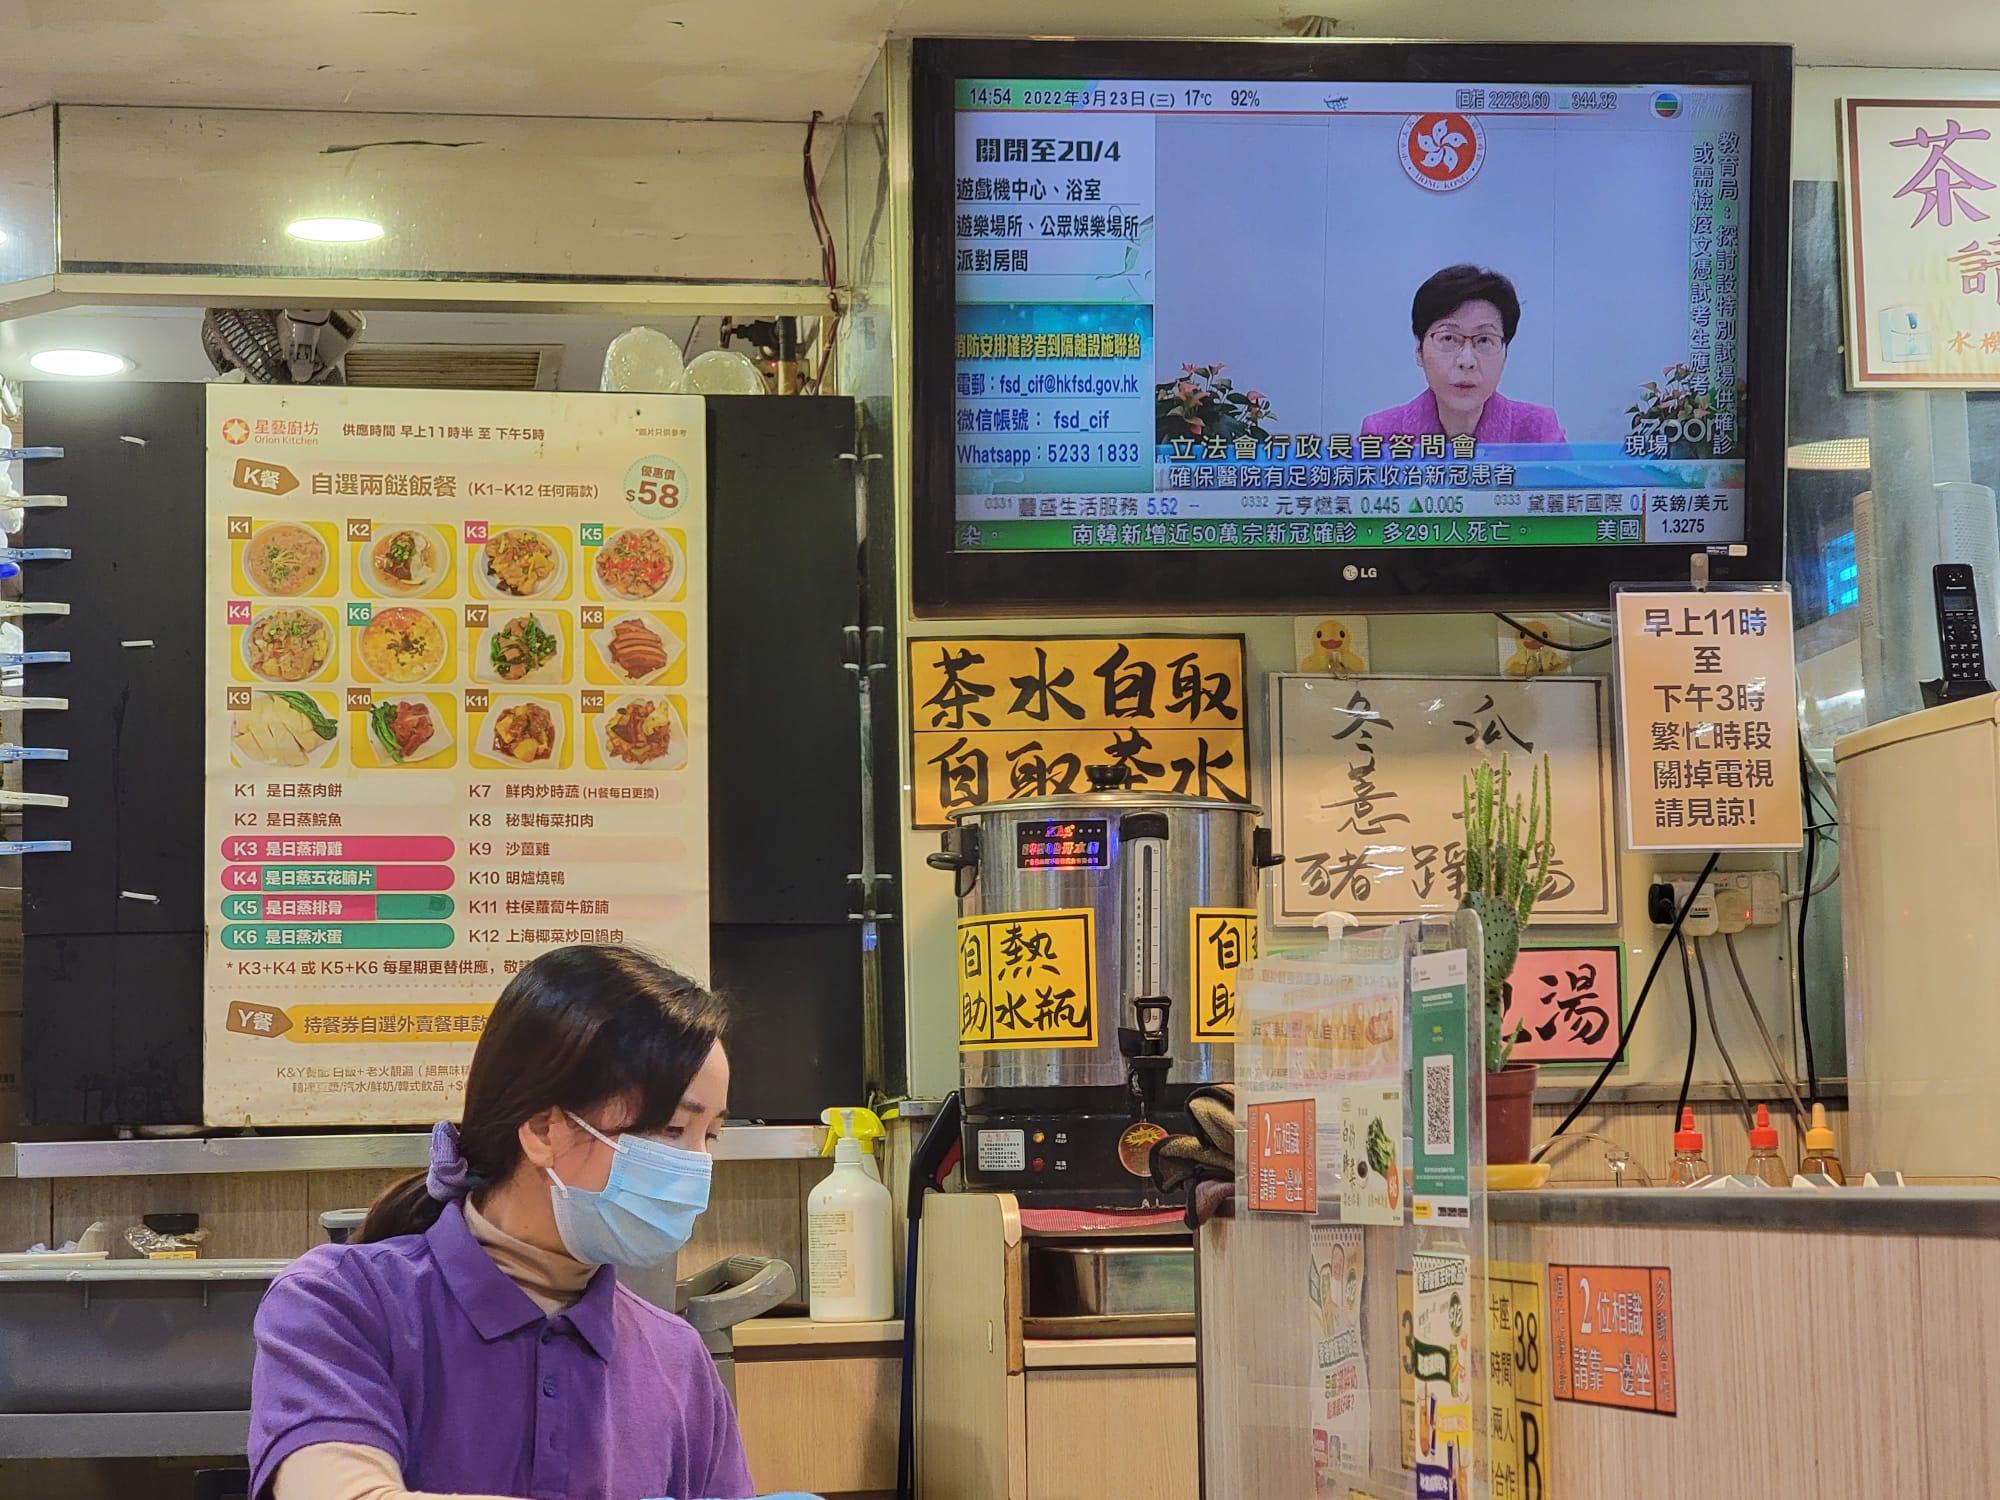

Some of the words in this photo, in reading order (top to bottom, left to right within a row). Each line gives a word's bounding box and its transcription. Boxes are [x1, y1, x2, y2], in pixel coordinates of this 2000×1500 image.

[970, 88, 1012, 105] 14:54
[1231, 90, 1260, 107] 92%
[976, 138, 1121, 163] 關閉至20/4
[1889, 118, 1998, 229] 茶
[956, 178, 1101, 201] 遊戲機中心、浴室
[956, 215, 1139, 238] 遊樂場所、公眾娛樂場所
[956, 249, 1028, 272] 派對房間
[254, 419, 319, 436] 星藝廚坊
[343, 423, 396, 437] 供應時間
[400, 424, 473, 439] 早上11時半
[478, 427, 491, 439] 至
[496, 427, 545, 440] 下午5時
[1053, 411, 1110, 433] fsd_cif
[254, 435, 280, 444] Orion
[282, 436, 318, 445] Kitchen
[1169, 433, 1477, 461] 立法會行政長官答問會
[1625, 435, 1668, 456] 現場
[1097, 444, 1139, 463] 1833
[244, 466, 281, 490] K餐
[641, 465, 676, 481] 優惠價
[1169, 464, 1515, 488] 確保醫院有足夠病床收治新冠患者
[311, 472, 457, 498] 自選兩餸飯餐
[1147, 497, 1178, 516] 5.52
[1361, 496, 1400, 514] 0.445
[1652, 494, 1729, 513] 英鎊/美元
[230, 521, 250, 534] K1
[349, 523, 369, 537] K2
[467, 526, 487, 539] K3
[1597, 519, 1640, 541] 美國
[1662, 518, 1705, 535] 1.3275
[582, 528, 602, 542] K5
[1360, 567, 1377, 578] LG
[229, 606, 250, 619] K4
[349, 608, 370, 621] K6
[466, 609, 488, 622] K7
[582, 610, 602, 624] K8
[1643, 607, 1768, 637] 早上11時
[1693, 646, 1722, 674] 至
[921, 642, 1238, 729] 茶水自取
[229, 692, 250, 704] K9
[348, 693, 371, 706] K10
[465, 694, 488, 707] K11
[582, 696, 603, 707] K12
[1653, 683, 1765, 713] 下午3時
[1651, 721, 1772, 751] 繁忙時段
[928, 726, 1248, 808] 自取茶水
[1653, 759, 1774, 789] 關掉電視
[235, 784, 255, 797] K1
[266, 783, 342, 798] 是日蒸肉餅
[469, 785, 491, 797] K7
[505, 784, 580, 798] 鮮肉炒時蔬
[235, 813, 257, 826] K2
[266, 812, 342, 827] 是日蒸鯇魚
[469, 814, 492, 827] K8
[505, 813, 594, 828] 秘製梅菜扣肉
[234, 842, 258, 856] K3
[266, 841, 343, 856] 是日蒸滑雞
[469, 843, 492, 855] K9
[234, 871, 258, 885] K4
[266, 870, 372, 886] 是日蒸五花腩片
[469, 871, 500, 884] K10
[505, 871, 565, 885] 明爐燒鴨
[234, 901, 258, 915] K5
[266, 900, 342, 915] 是日蒸排骨
[469, 900, 497, 913] K11
[233, 930, 257, 944] K6
[265, 929, 342, 945] 是日蒸水蛋
[469, 930, 499, 943] K12
[238, 961, 297, 975] K3+K4
[300, 961, 316, 975] 或
[321, 961, 378, 975] K5+K6
[961, 930, 988, 1036] 自助
[237, 1009, 273, 1032] Y餐
[1514, 1310, 1540, 1375] 38
